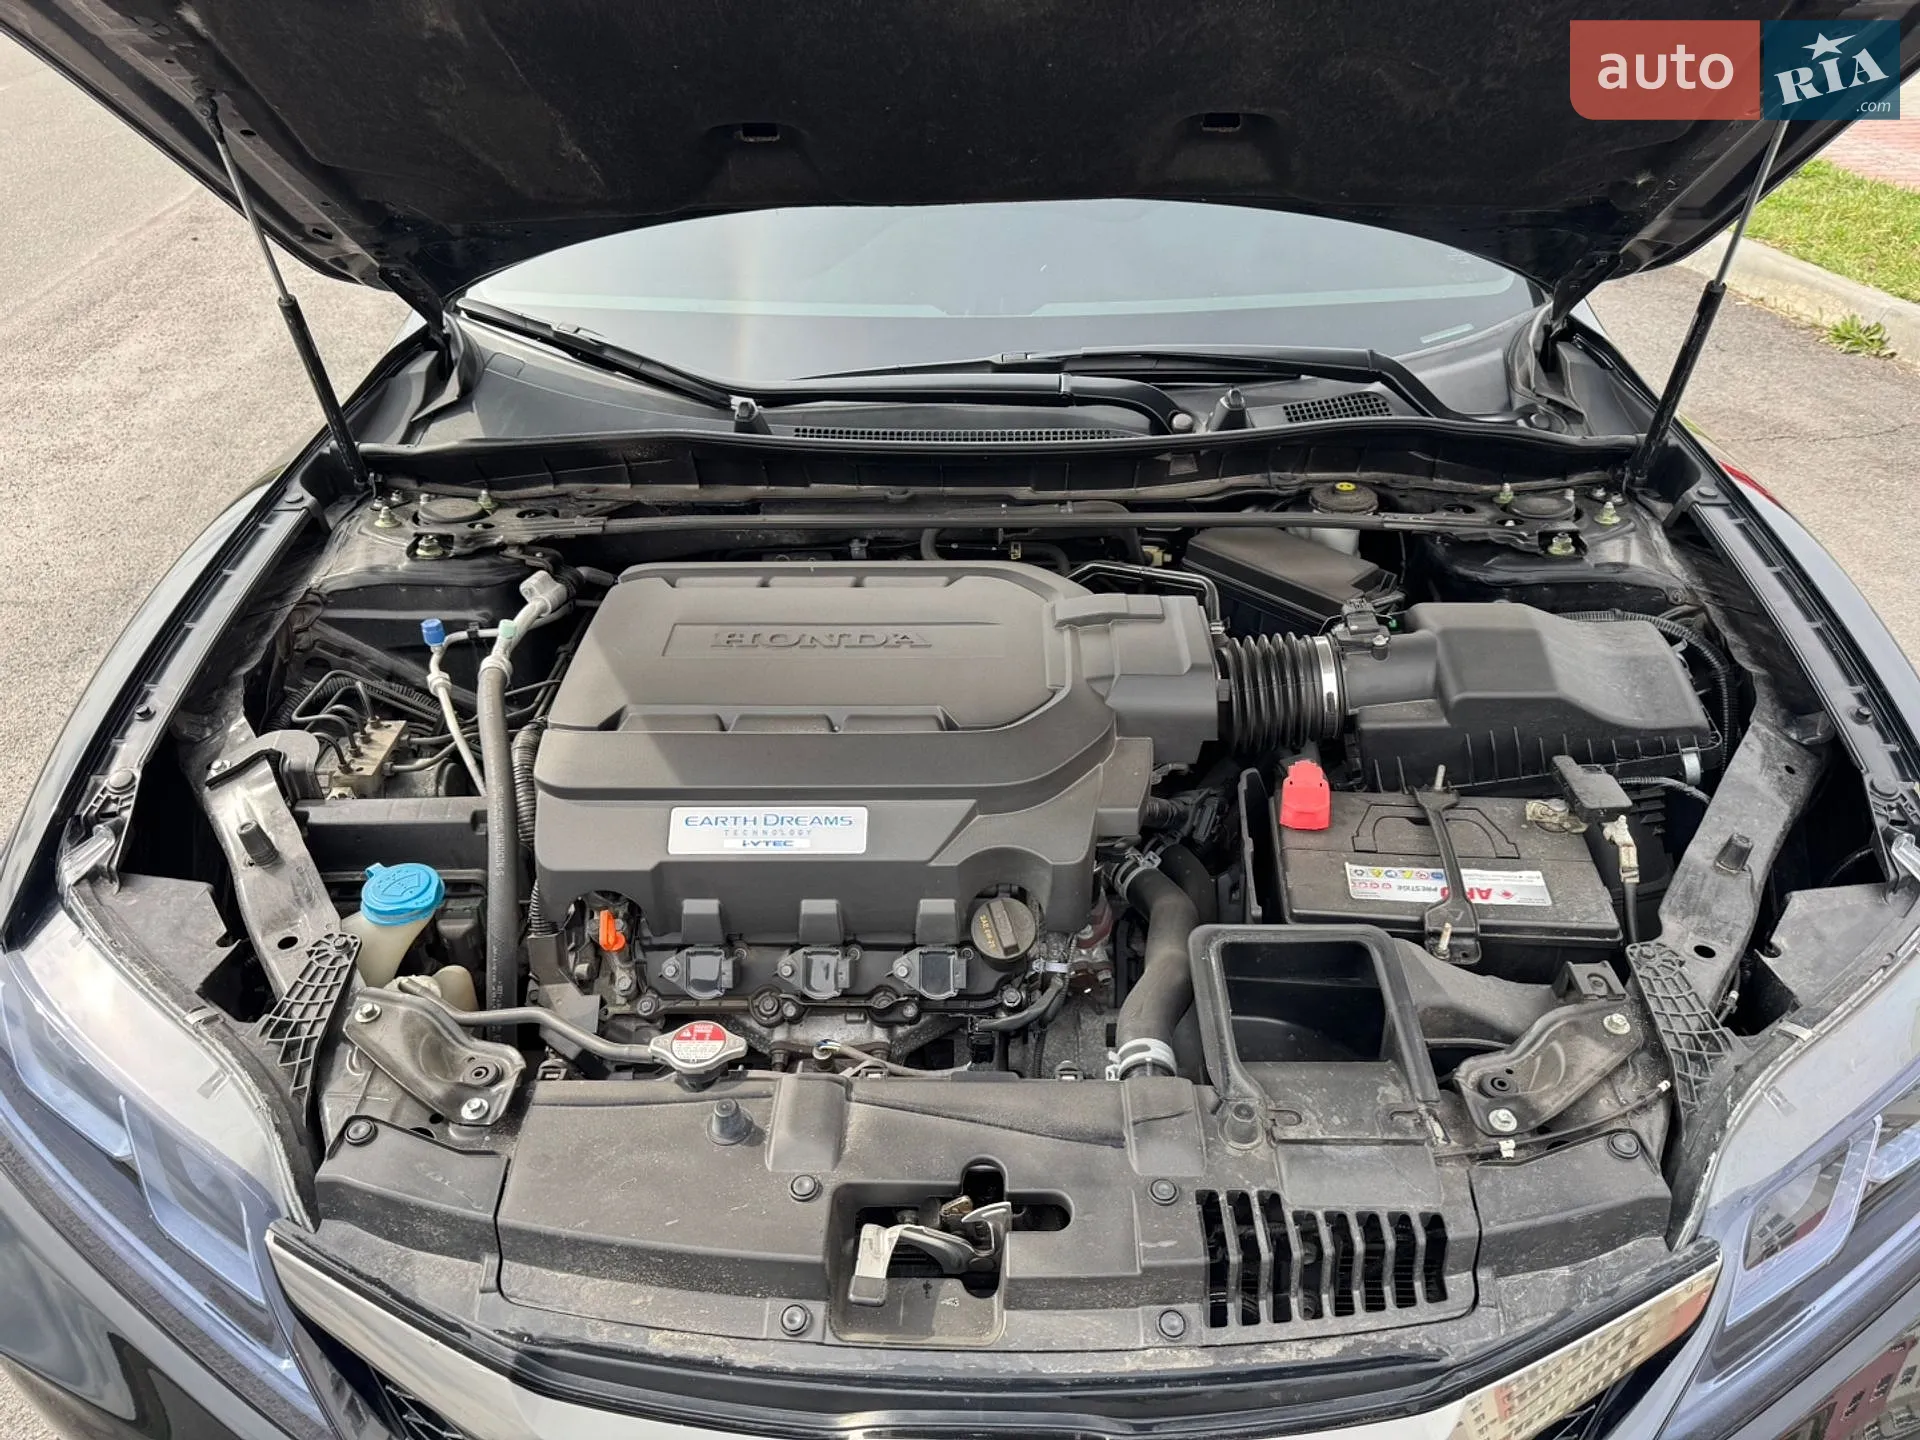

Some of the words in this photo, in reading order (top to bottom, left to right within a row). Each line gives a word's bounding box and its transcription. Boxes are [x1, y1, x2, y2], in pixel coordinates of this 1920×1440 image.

[711, 632, 933, 648] HONDA
[685, 815, 757, 827] EARTH
[763, 813, 853, 827] DREAMS
[742, 839, 794, 848] i-VTEC
[1397, 885, 1438, 893] PRESTIGE
